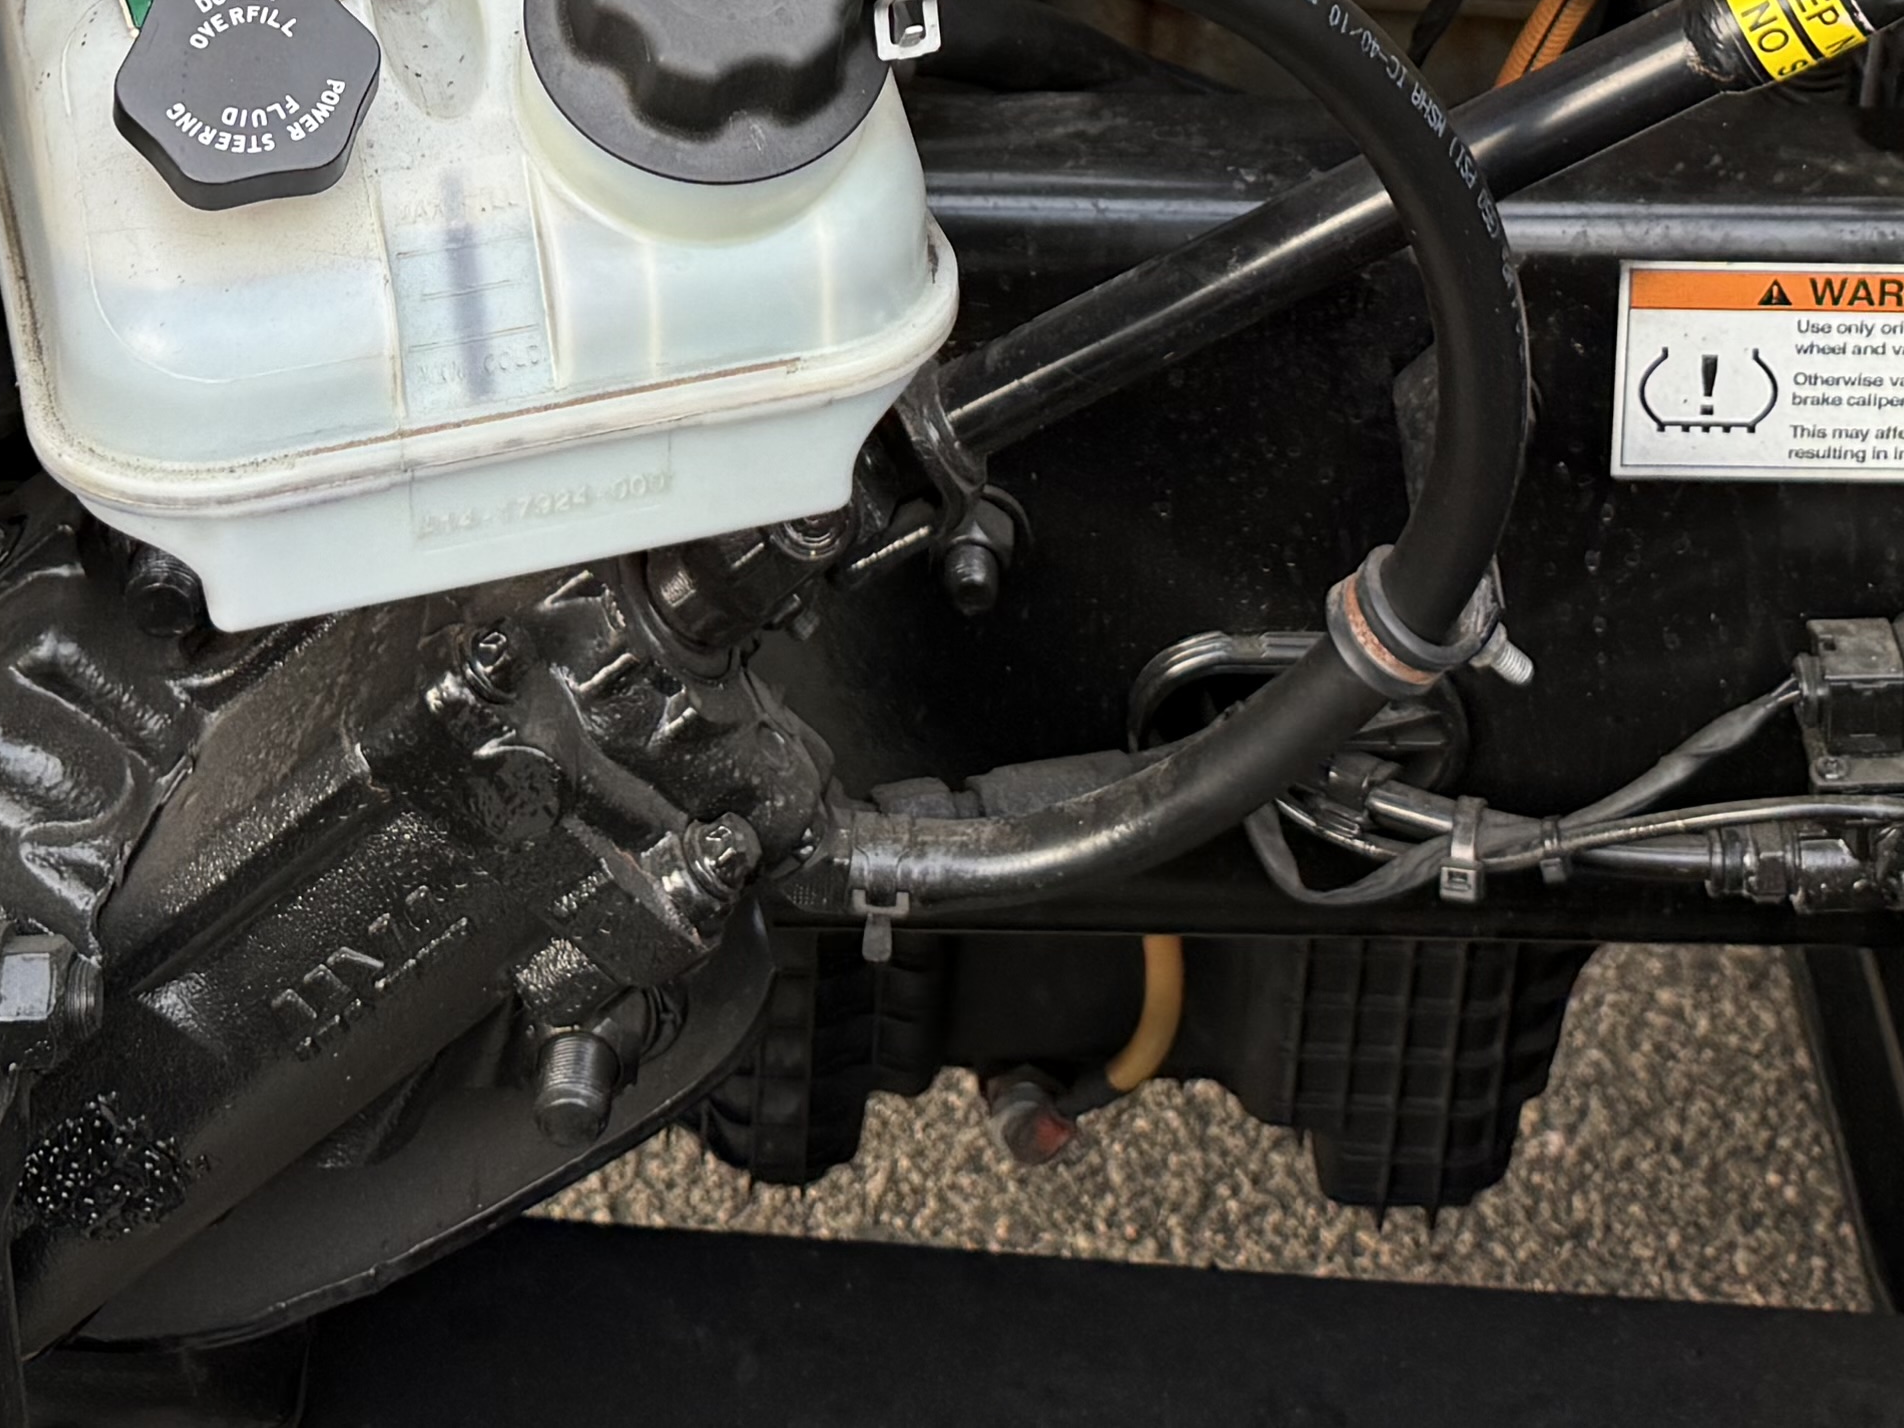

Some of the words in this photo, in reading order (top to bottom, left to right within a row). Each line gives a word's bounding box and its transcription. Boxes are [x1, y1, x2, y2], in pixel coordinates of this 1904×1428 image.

[189, 5, 298, 50] OVERFILL
[1741, 0, 1790, 53] NO
[1329, 3, 1409, 90] IC-40/10
[221, 94, 301, 128] FLUID
[289, 77, 346, 143] POWER
[1410, 81, 1447, 138] MSHA
[165, 101, 276, 154] STEERING
[1797, 320, 1832, 336] Use
[1837, 322, 1875, 339] only
[1795, 341, 1847, 357] wheel
[1852, 342, 1886, 357] and
[1793, 373, 1883, 389] Otherwise
[1791, 392, 1842, 408] brake
[1790, 425, 1827, 441] This
[1831, 428, 1870, 443] may
[1788, 446, 1867, 464] resulting
[1871, 447, 1889, 463] in
